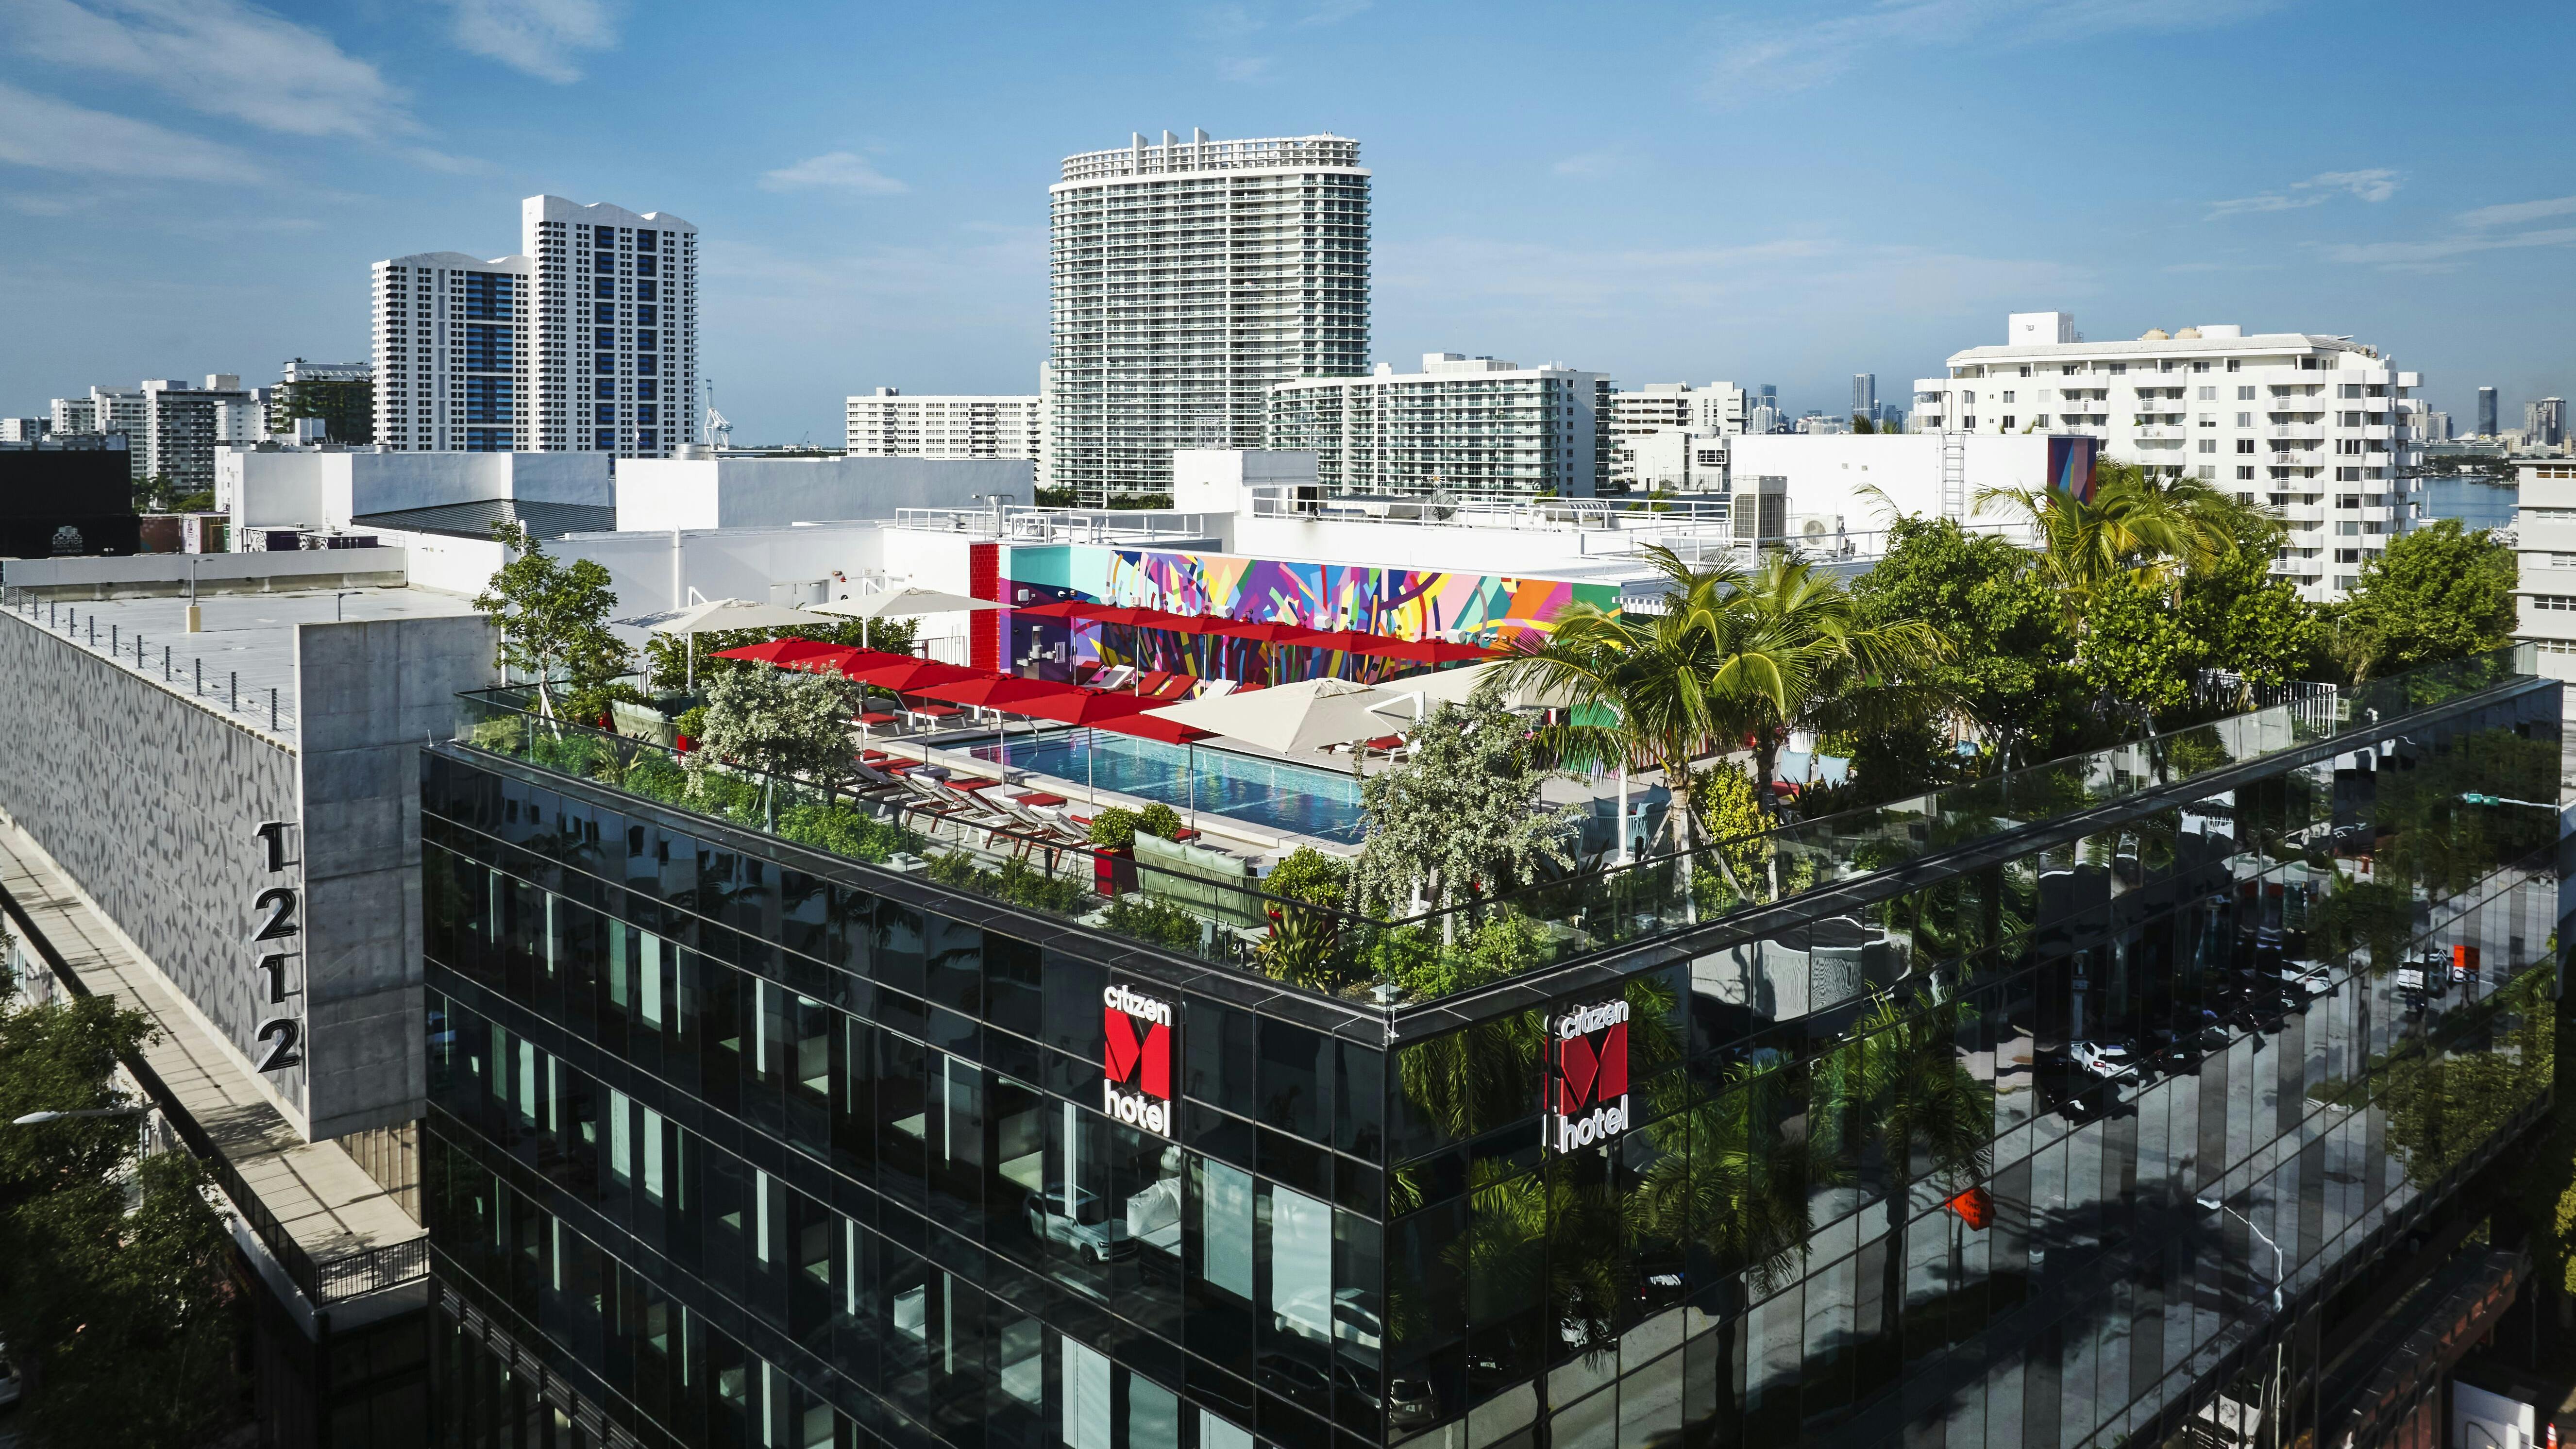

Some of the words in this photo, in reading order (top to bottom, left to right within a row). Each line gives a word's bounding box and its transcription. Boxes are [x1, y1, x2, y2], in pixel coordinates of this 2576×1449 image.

[251, 820, 299, 1073] 1212
[1104, 985, 1171, 1027] citizen
[1560, 1000, 1629, 1040] citizen
[1104, 1078, 1171, 1138] hotel
[1560, 1094, 1628, 1154] hotel
